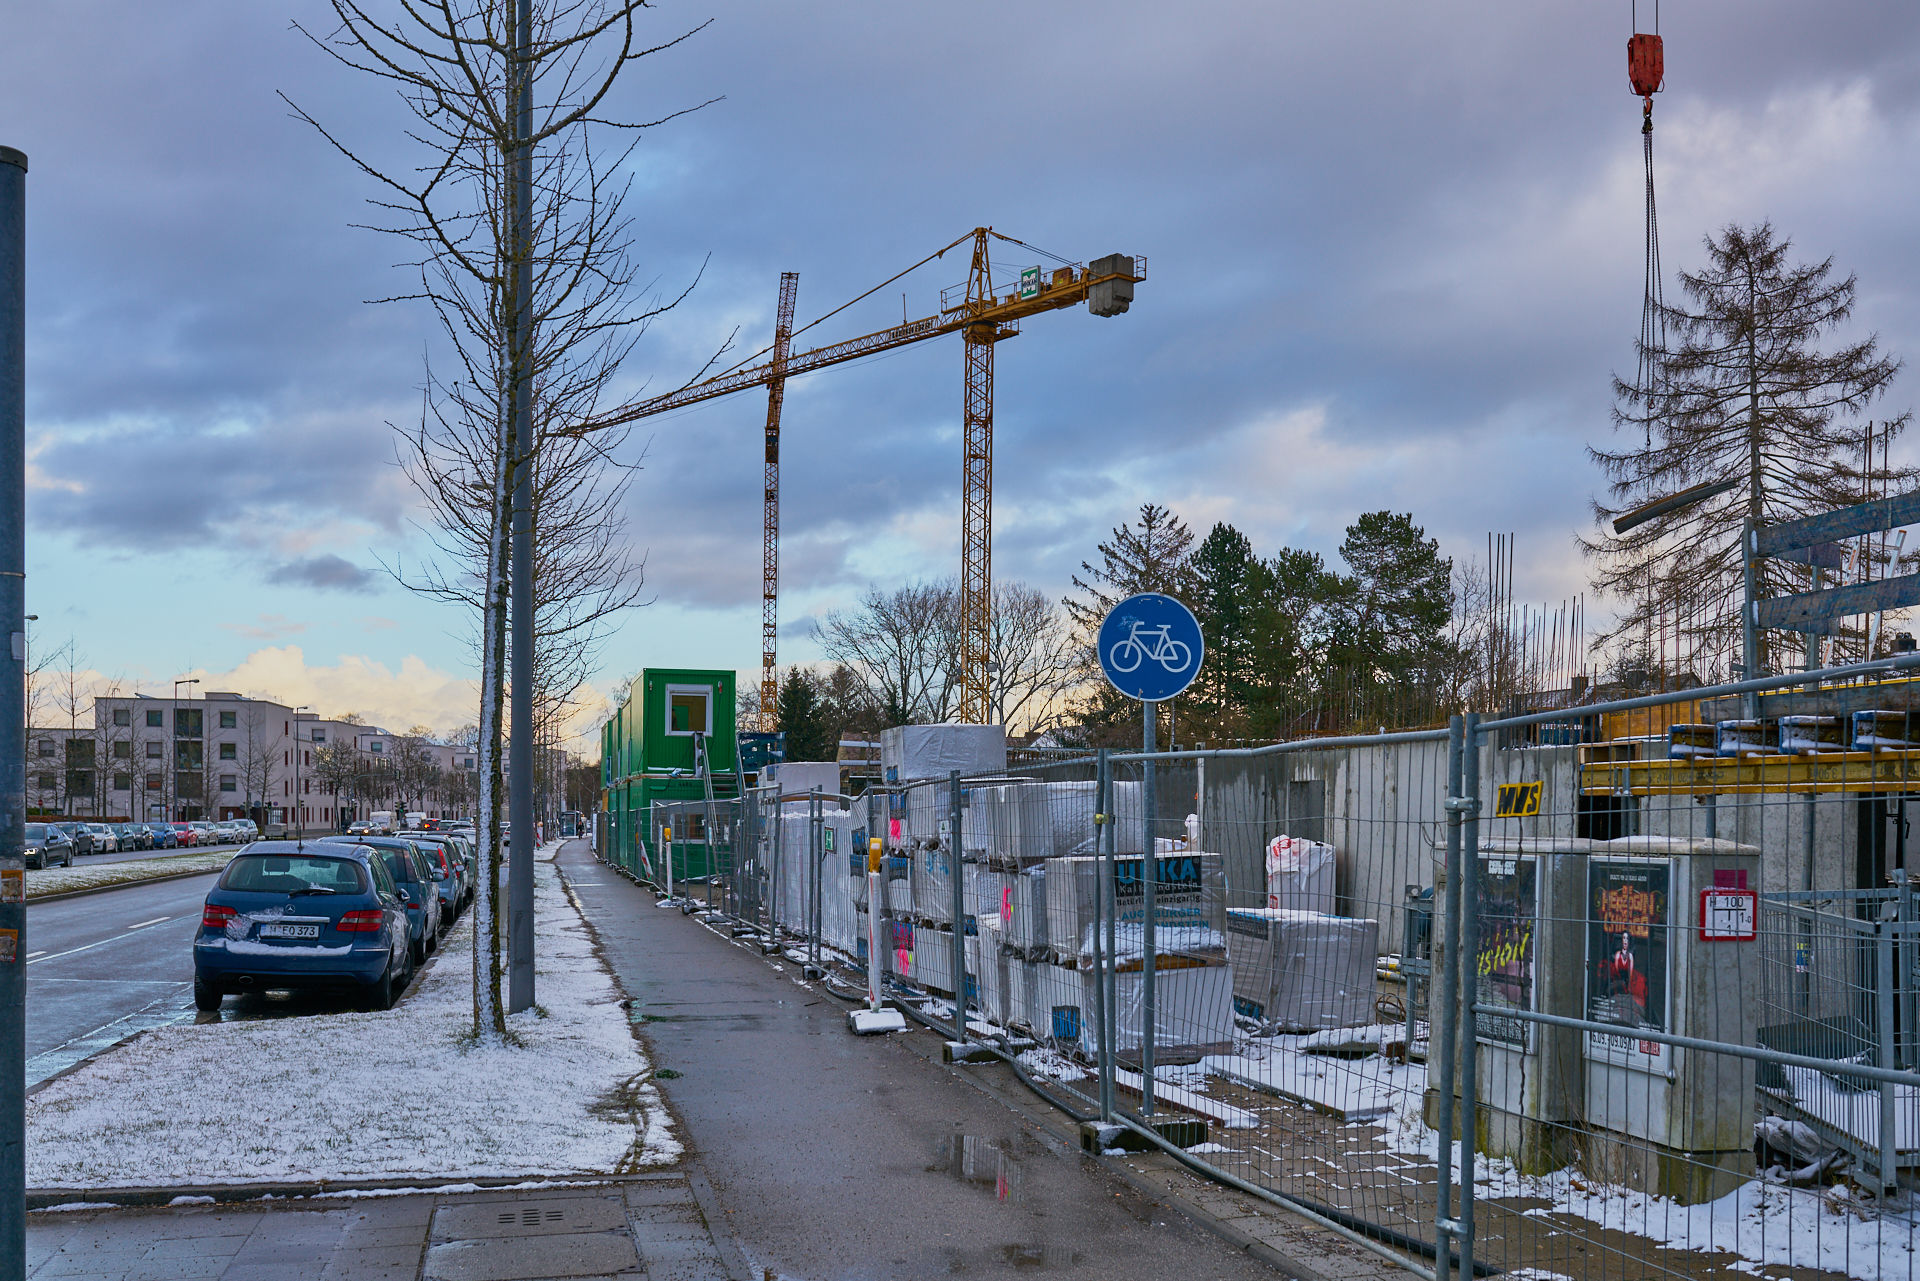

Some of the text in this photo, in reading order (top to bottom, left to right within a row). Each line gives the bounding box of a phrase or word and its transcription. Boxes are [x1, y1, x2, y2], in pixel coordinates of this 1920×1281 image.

[1119, 881, 1198, 894] Kalkndstein
[1725, 896, 1744, 908] 100
[1121, 907, 1202, 921] AUGBURGER
[297, 926, 315, 936] 373
